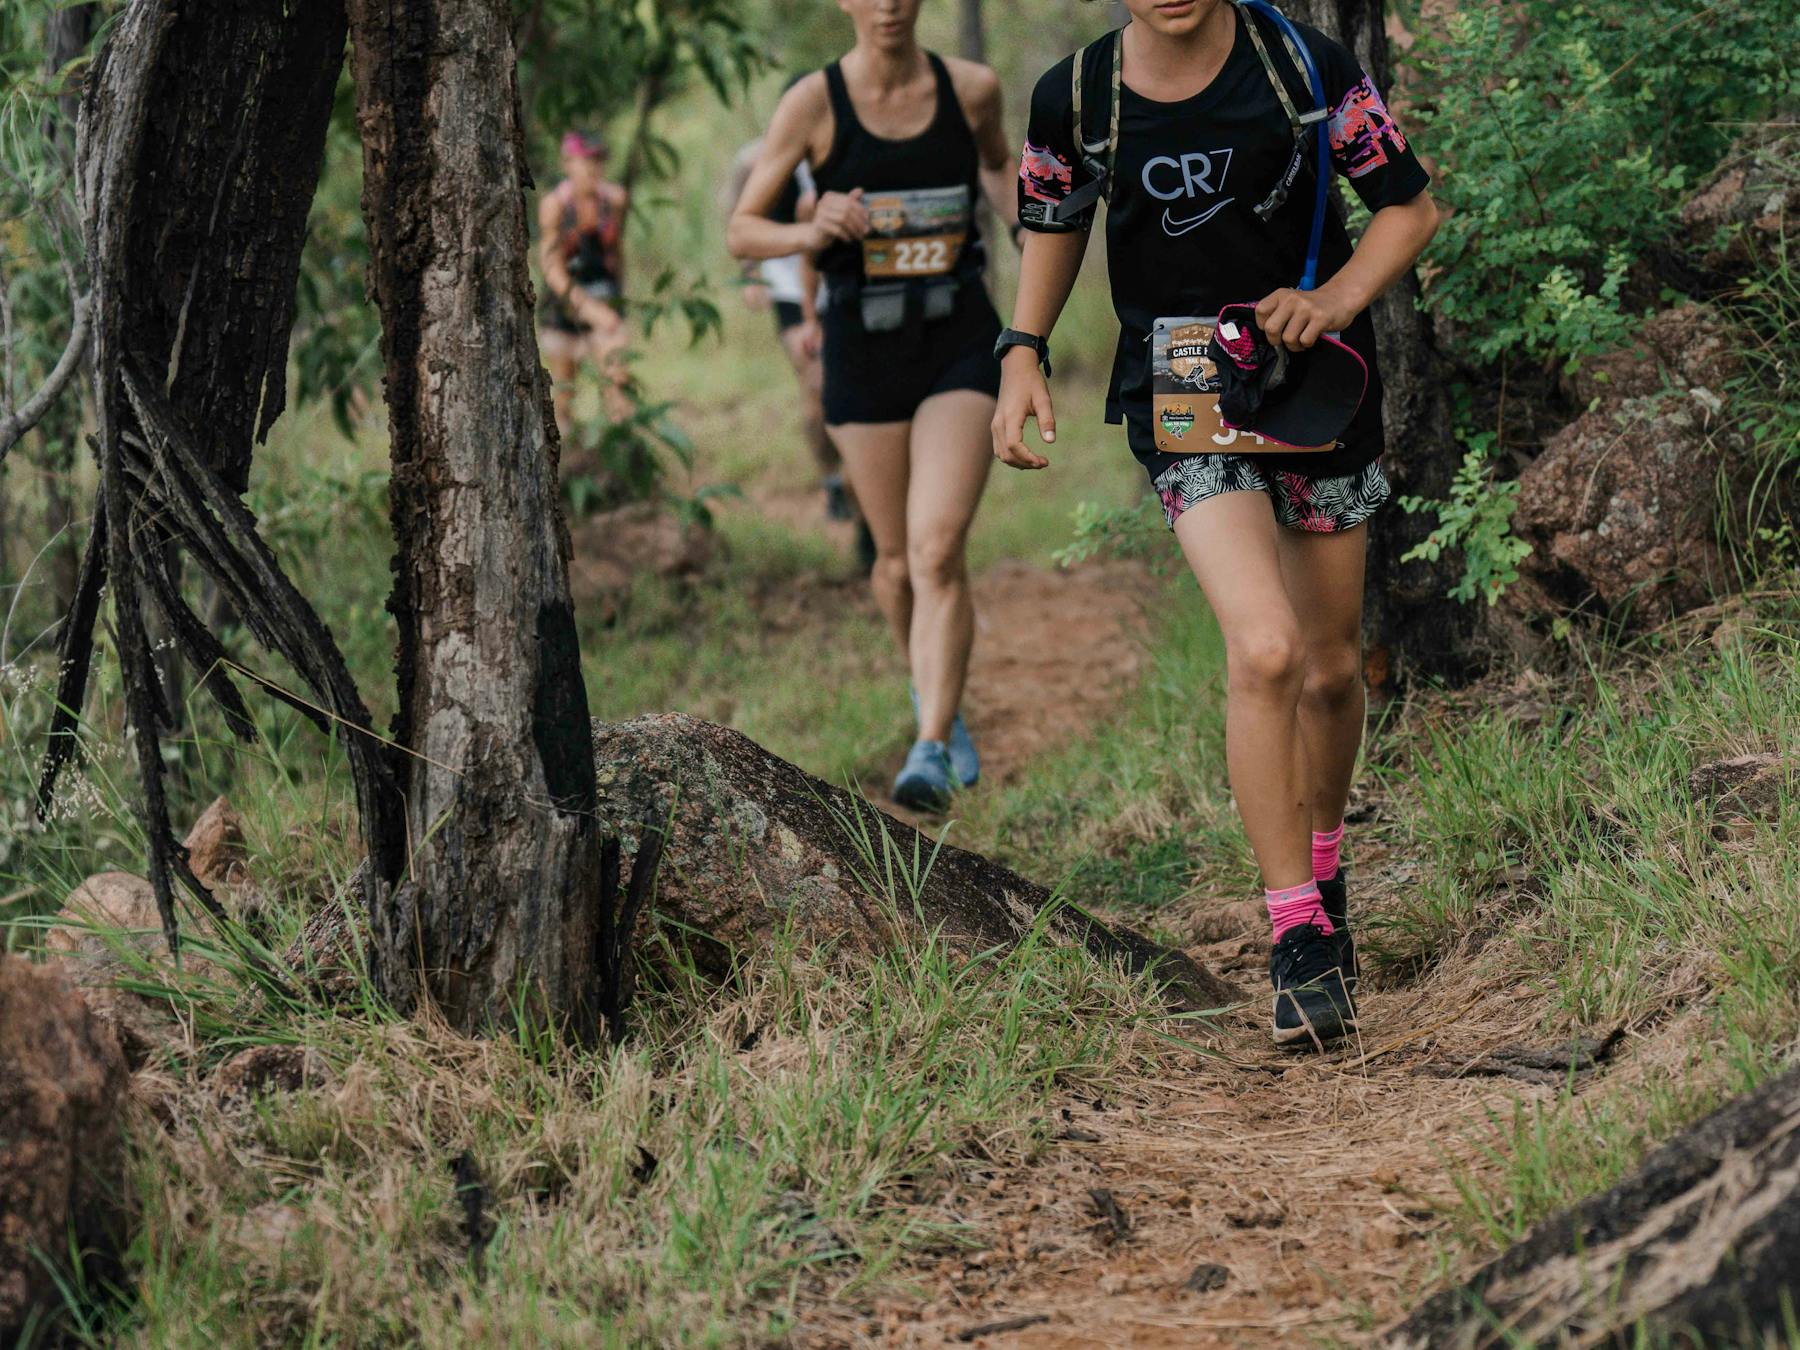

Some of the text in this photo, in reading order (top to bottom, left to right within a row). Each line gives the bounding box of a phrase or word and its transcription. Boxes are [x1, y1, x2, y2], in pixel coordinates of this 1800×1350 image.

[1142, 148, 1233, 200] CR7
[895, 240, 946, 271] 222
[1173, 346, 1202, 358] CASTLE
